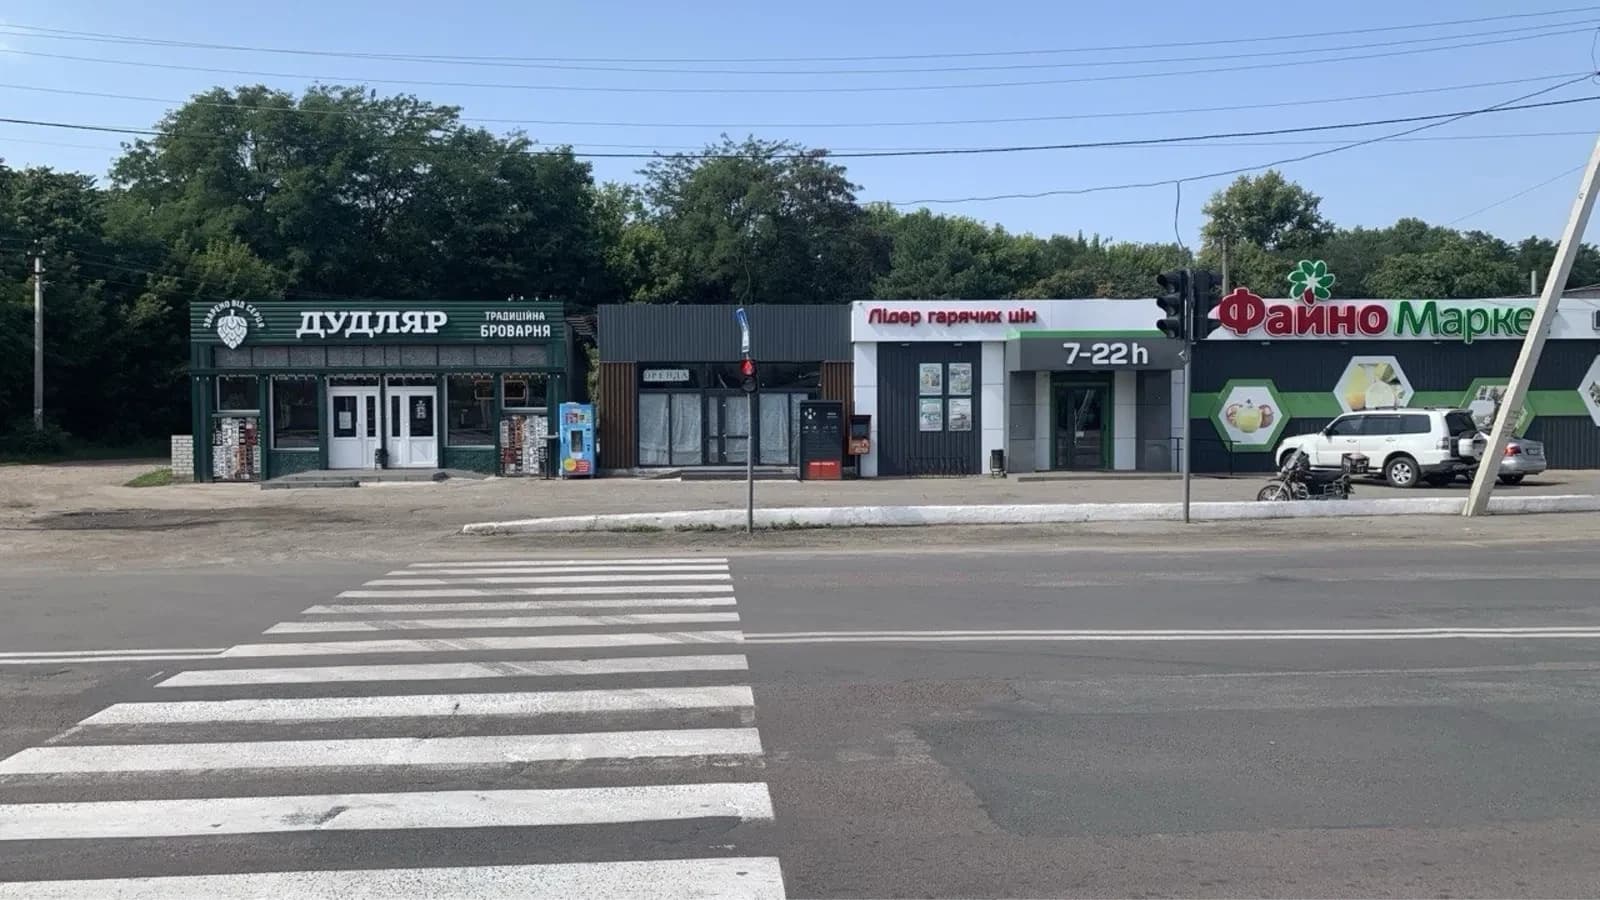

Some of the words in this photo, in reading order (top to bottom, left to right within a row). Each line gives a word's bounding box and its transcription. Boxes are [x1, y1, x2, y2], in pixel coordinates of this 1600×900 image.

[296, 311, 448, 338] ДУДЛЯР
[485, 310, 546, 321] ТРАДИЦІЙНА
[868, 308, 922, 327] Лідер
[927, 309, 1002, 327] гарячих
[1008, 308, 1037, 324] цін
[1219, 287, 1389, 336] Файно
[1395, 300, 1538, 344] Марке
[480, 324, 551, 338] БРОВАРНЯ
